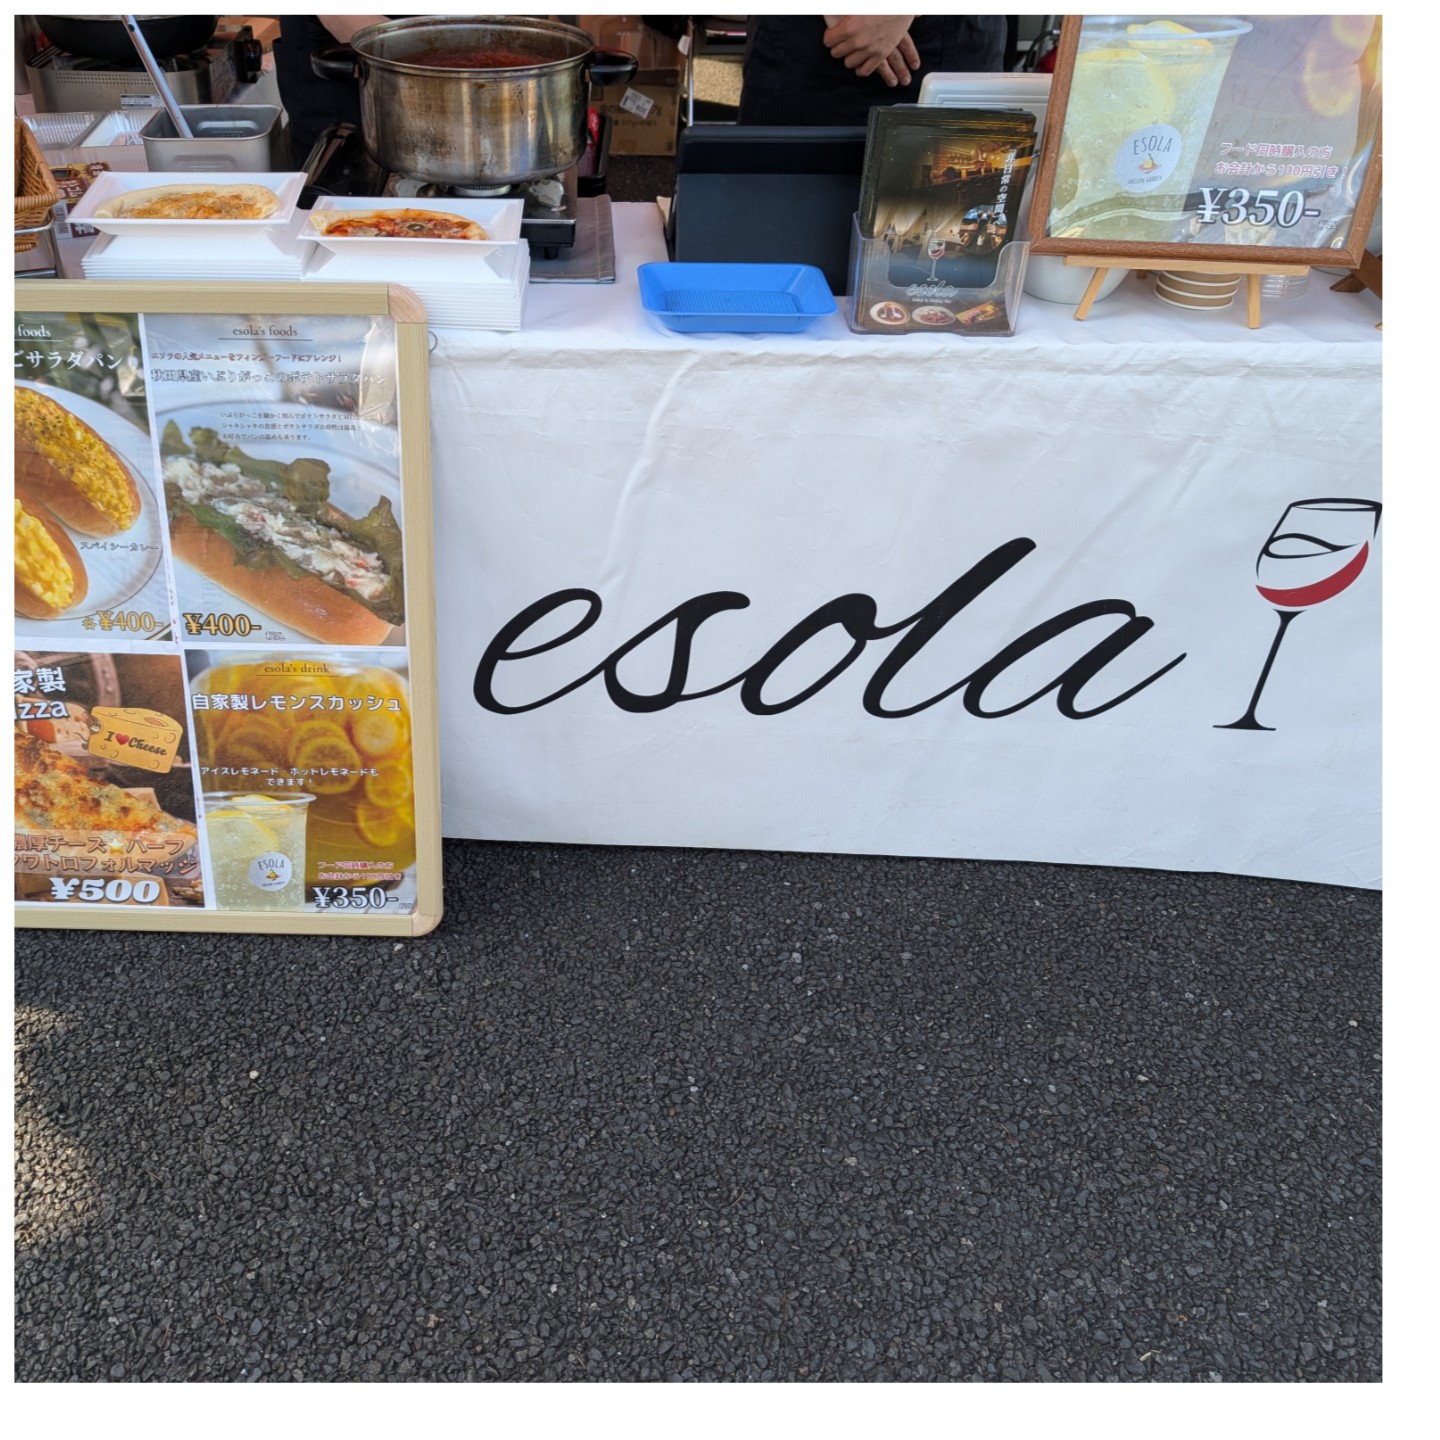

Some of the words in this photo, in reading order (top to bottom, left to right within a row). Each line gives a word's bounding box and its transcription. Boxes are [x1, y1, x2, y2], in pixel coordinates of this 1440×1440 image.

[1133, 135, 1173, 155] ESOLA
[17, 323, 51, 337] foods
[232, 325, 266, 337] esola's
[268, 324, 298, 337] foods
[80, 541, 160, 551] スパイシーカレー
[473, 536, 1188, 720] esola
[264, 662, 297, 673] esola's
[300, 662, 331, 674] drink
[192, 694, 401, 711] 自家製レモンスカッシュ
[103, 731, 113, 742] I
[128, 737, 168, 756] Cheese
[126, 839, 185, 854] ハーフ
[258, 858, 285, 870] ESOLA
[49, 877, 160, 903] ¥500
[312, 886, 399, 909] ¥350-
